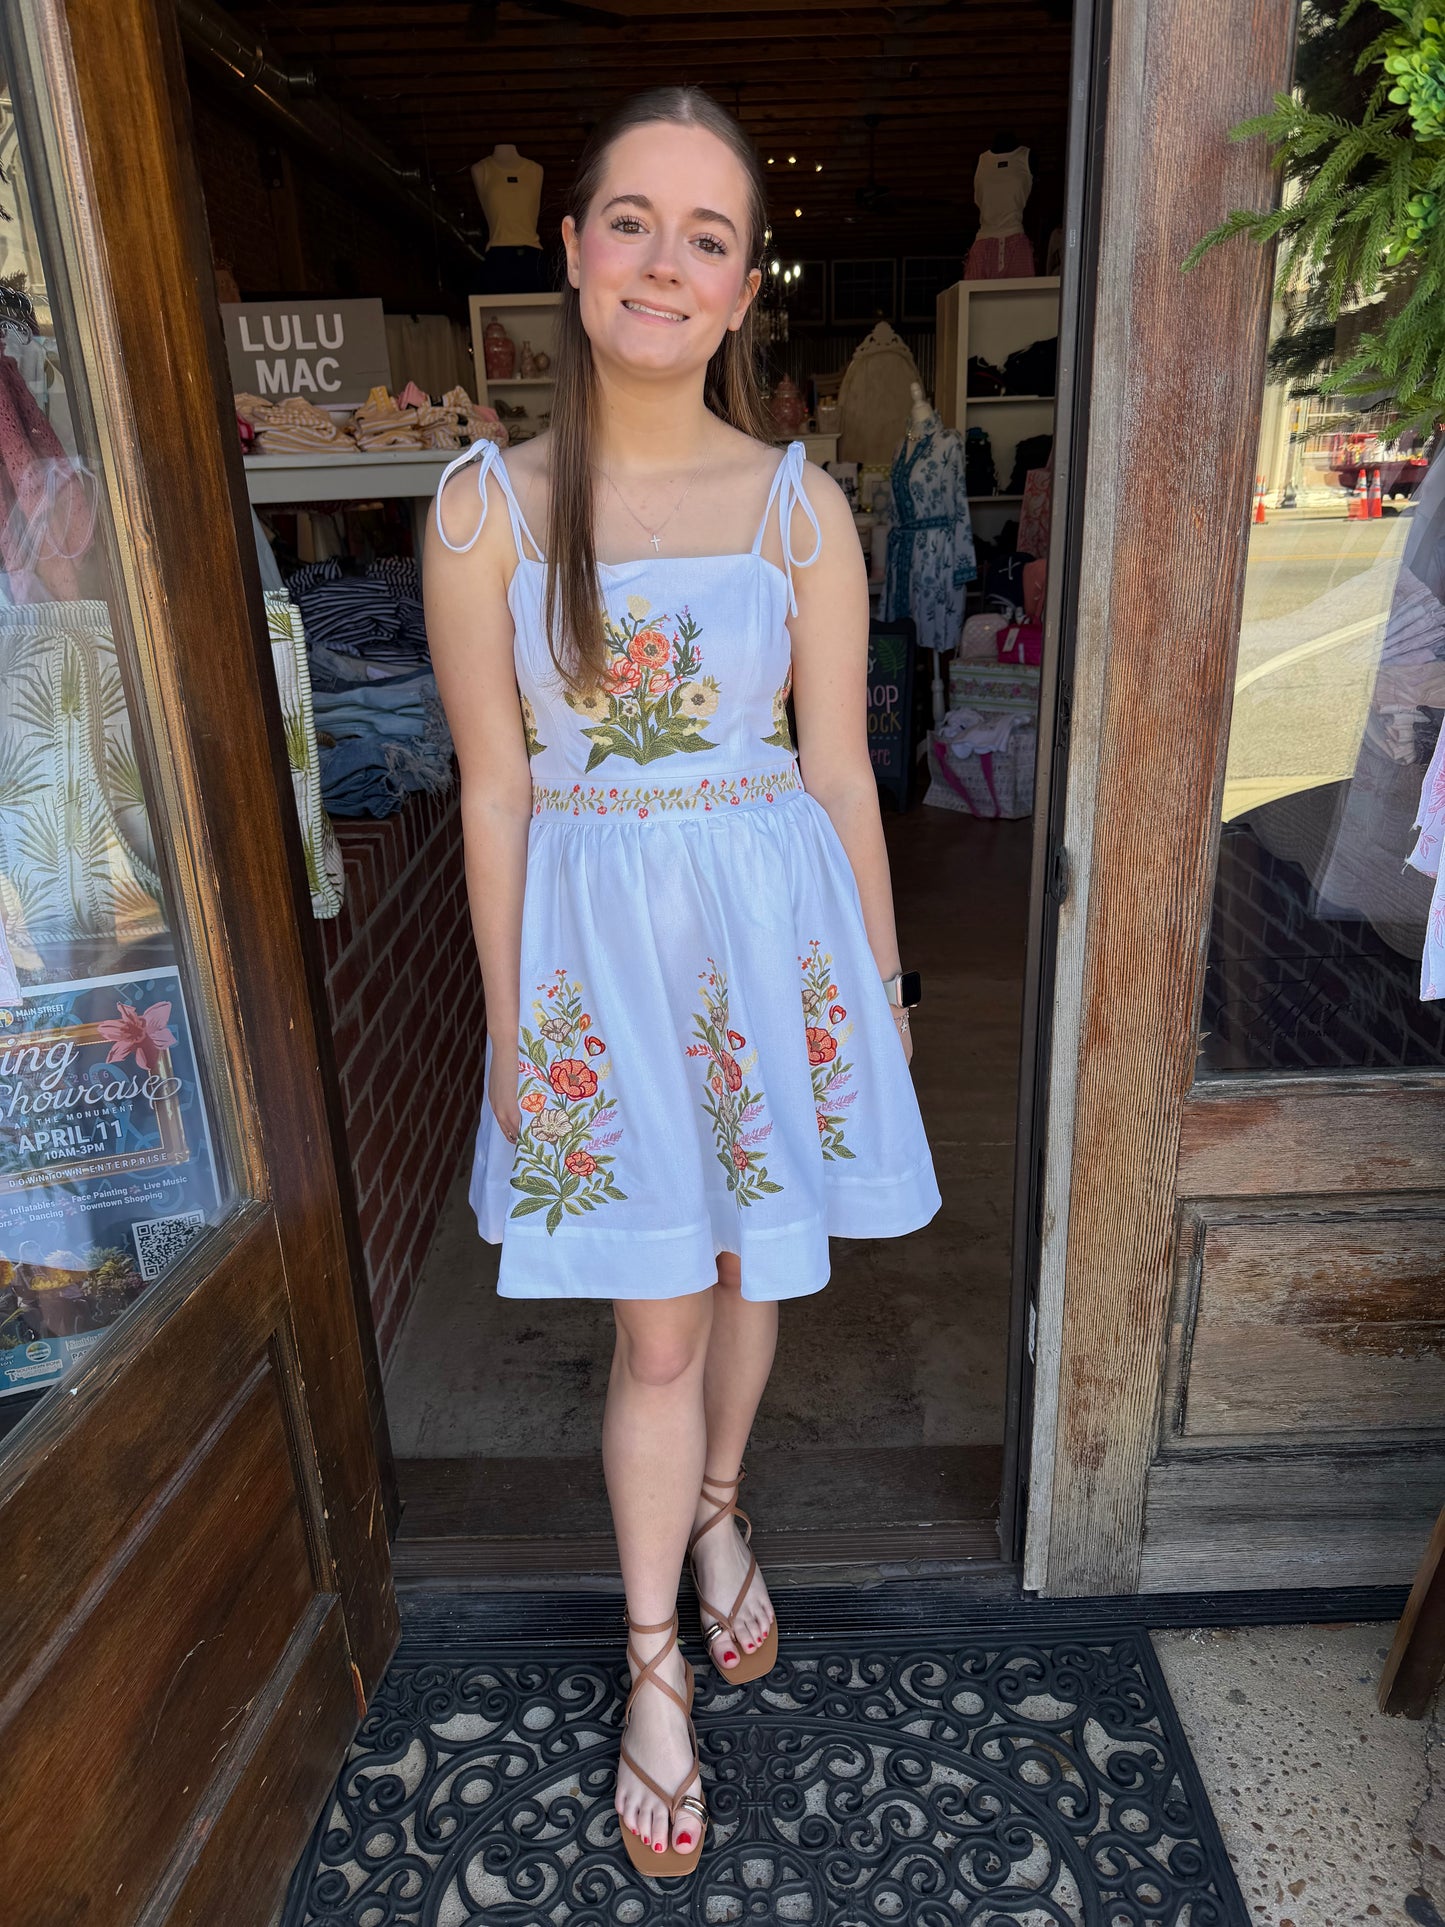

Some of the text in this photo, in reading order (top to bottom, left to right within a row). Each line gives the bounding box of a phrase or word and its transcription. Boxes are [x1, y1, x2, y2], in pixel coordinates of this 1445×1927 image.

[238, 313, 344, 352] LULU
[255, 357, 342, 394] MAC
[15, 1004, 64, 1018] MAIN STREET
[14, 1104, 135, 1130] AT THE MONUMENT
[18, 1119, 124, 1154] APRIL 11
[44, 1142, 105, 1161] 10AM-3PM
[8, 1152, 168, 1188] DOWNTOWN ENTERPRISE
[10, 1176, 188, 1215] Inflatables Face Painting Live Music
[29, 1210, 64, 1222] Dancing
[80, 1198, 123, 1212] Downtown
[124, 1191, 163, 1205] Shopping
